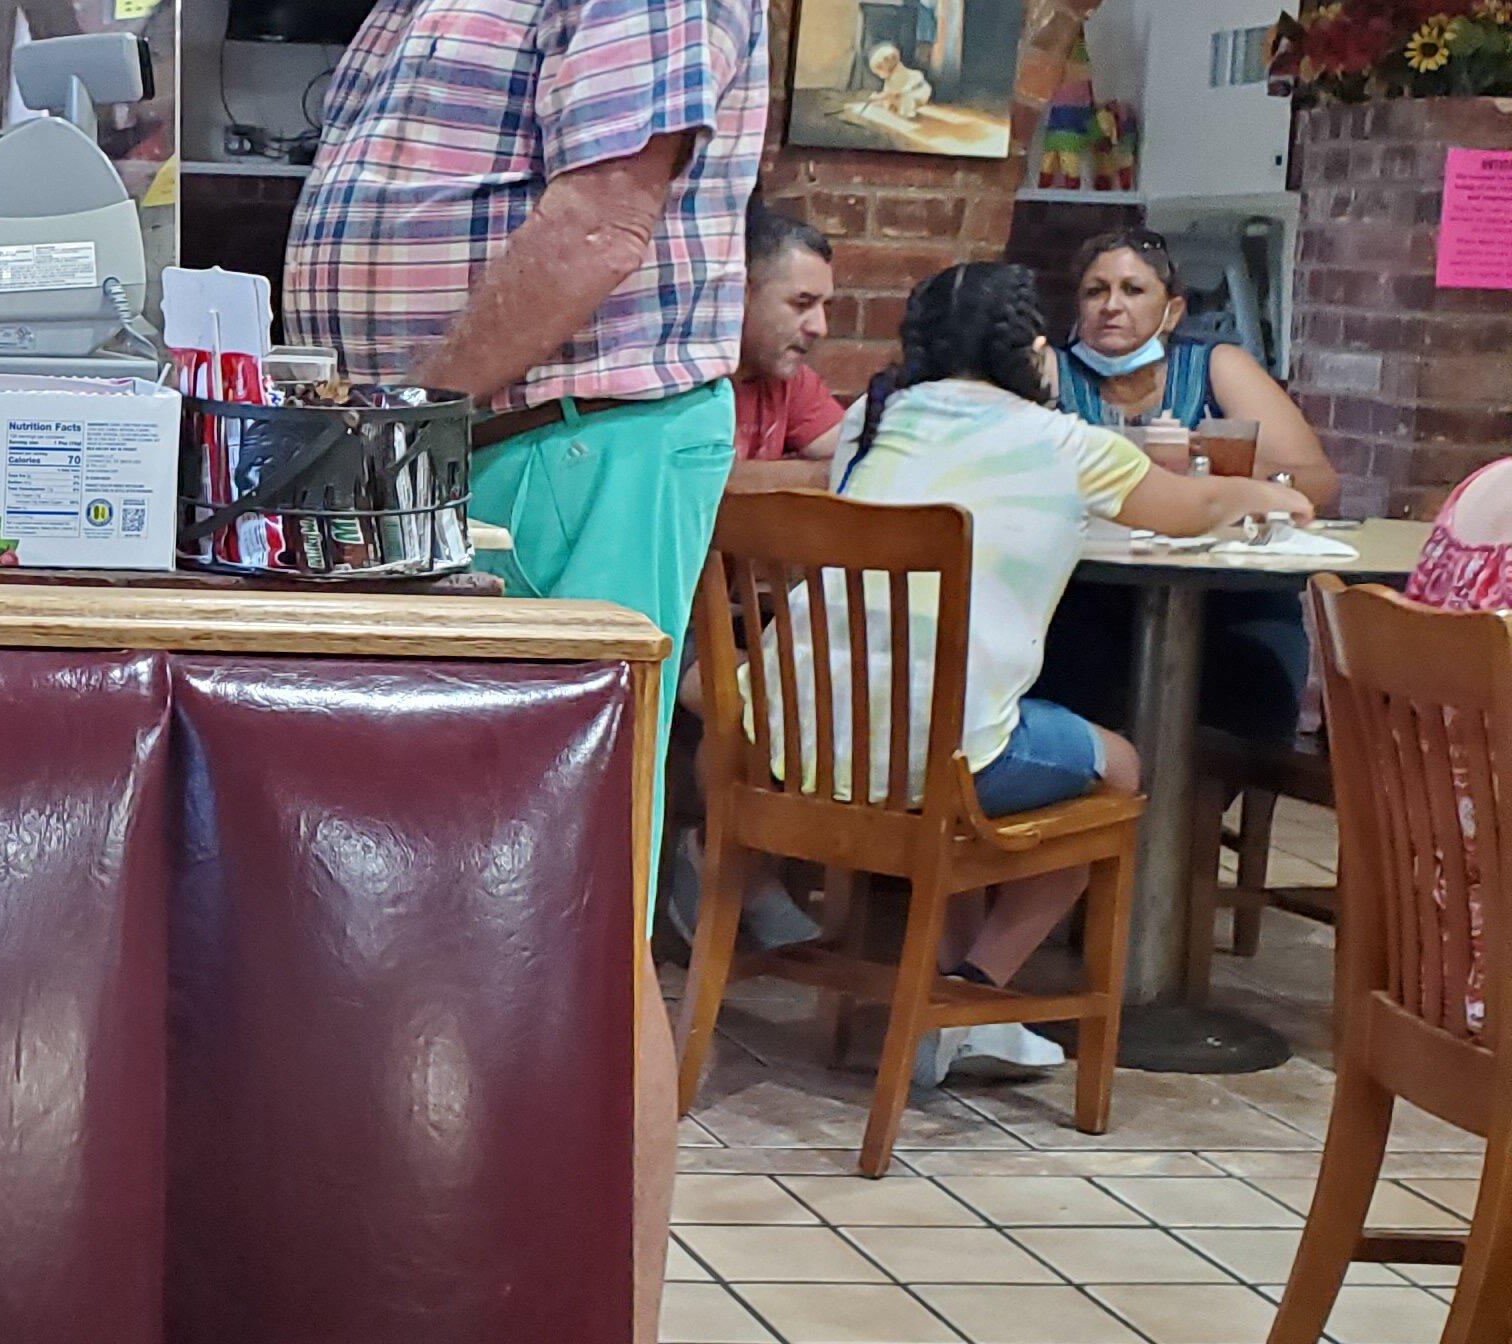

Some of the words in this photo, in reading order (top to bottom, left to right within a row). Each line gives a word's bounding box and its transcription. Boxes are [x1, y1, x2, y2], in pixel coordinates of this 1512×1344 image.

[8, 422, 52, 431] Nutrition
[55, 422, 82, 432] Facts
[8, 456, 41, 464] Calories
[67, 455, 82, 465] 70
